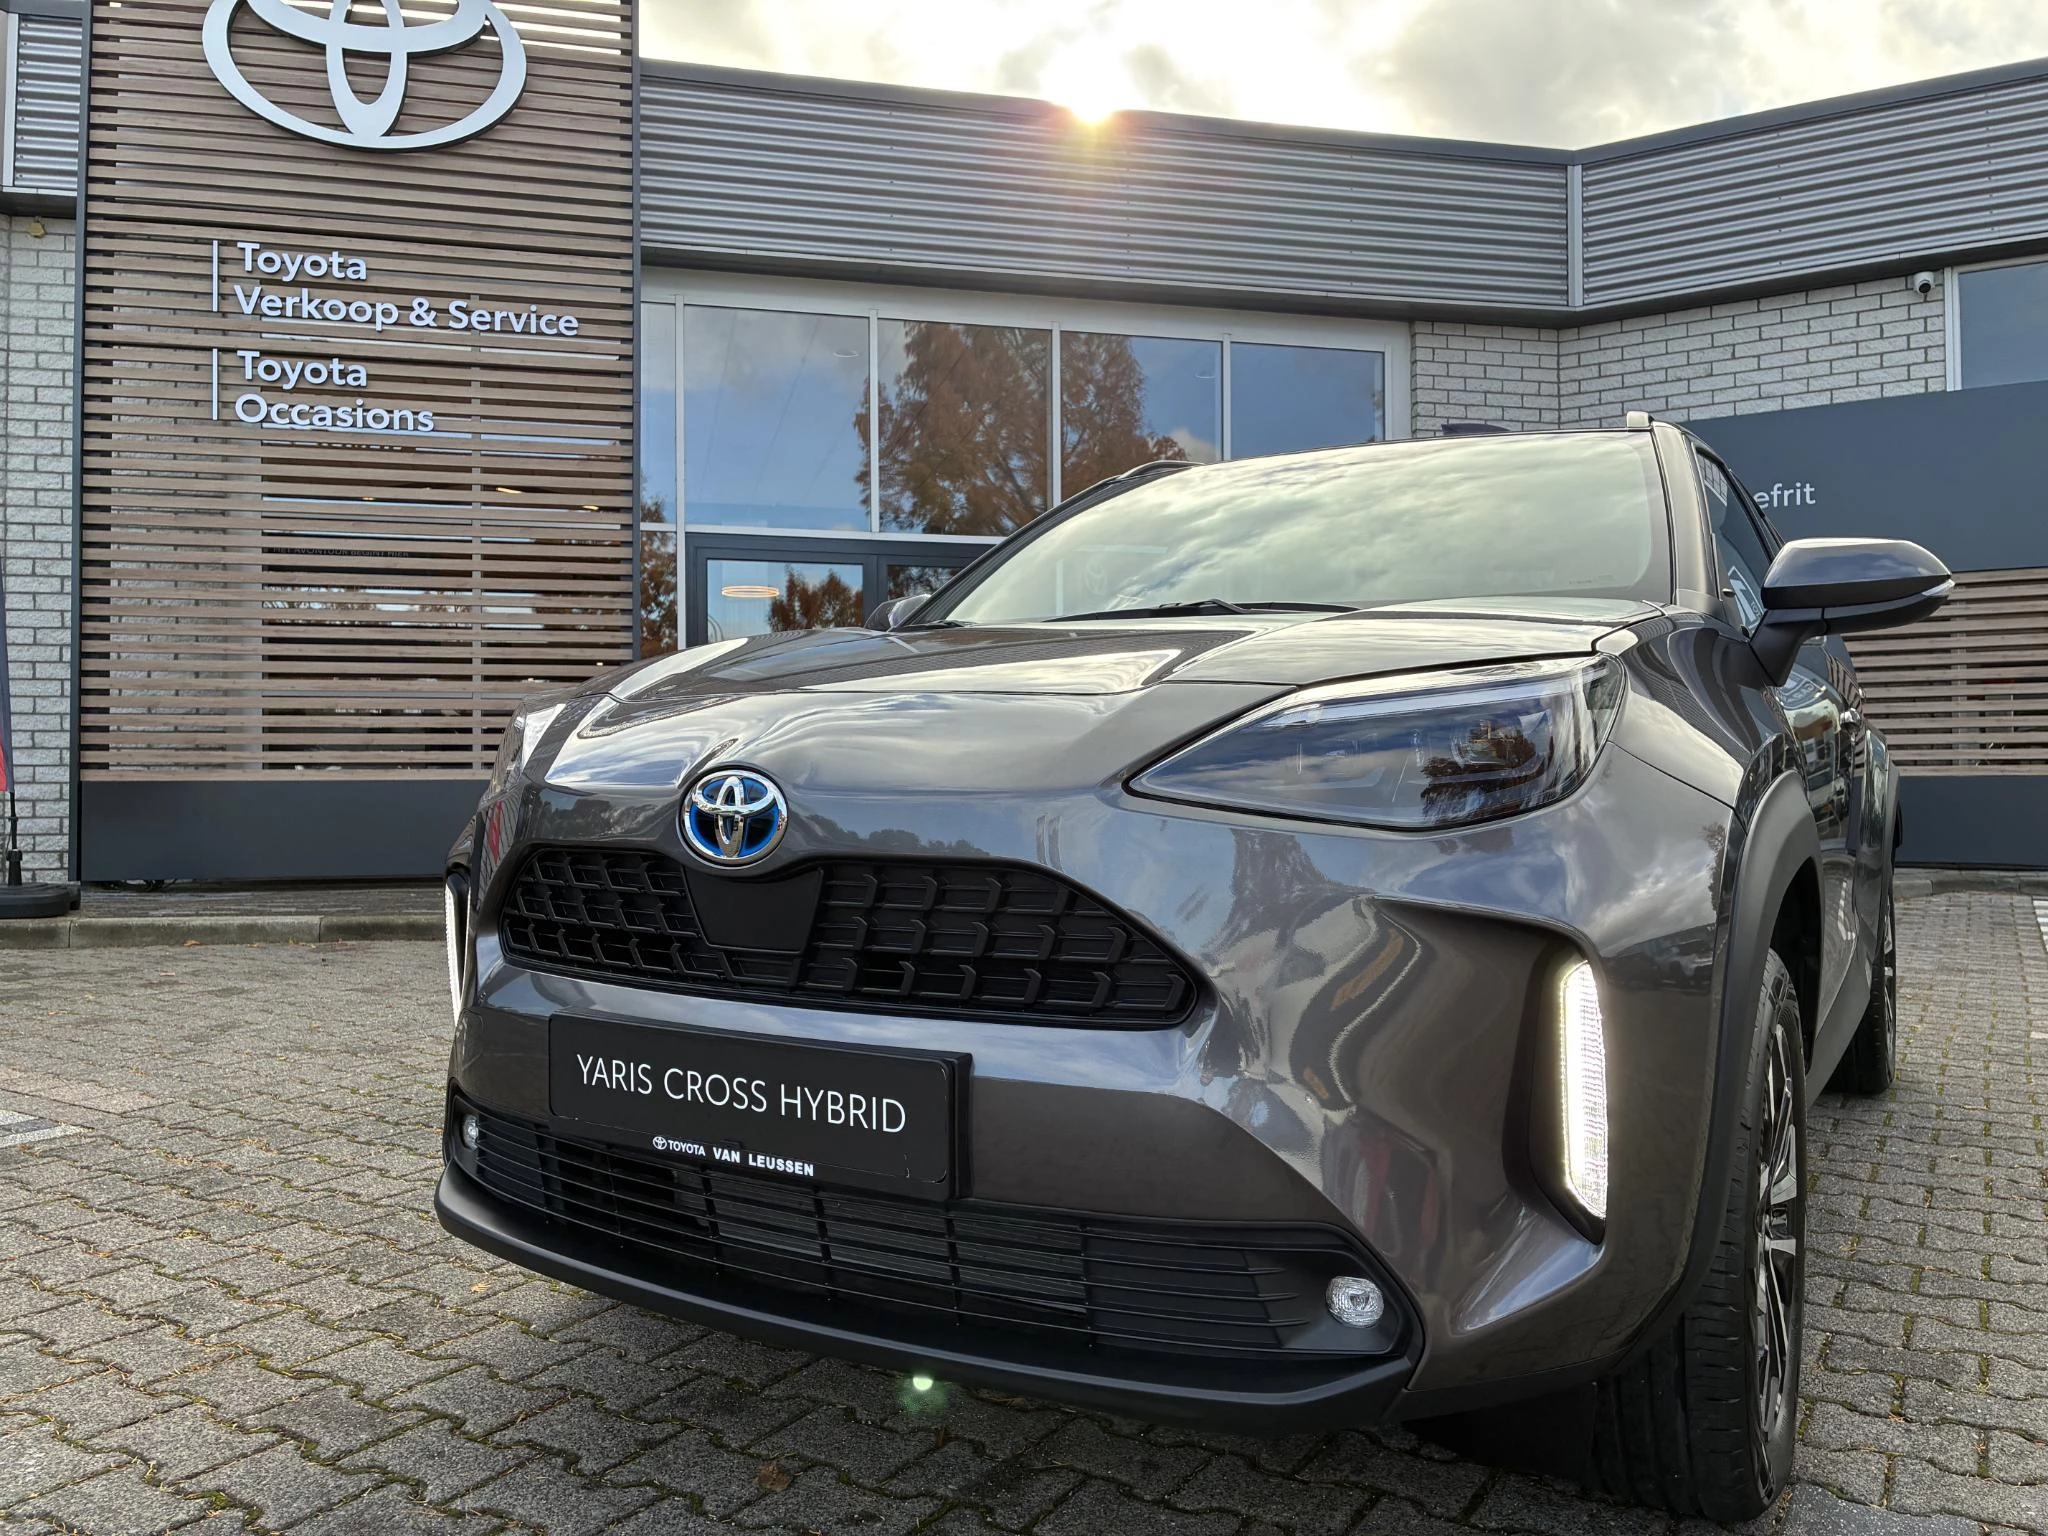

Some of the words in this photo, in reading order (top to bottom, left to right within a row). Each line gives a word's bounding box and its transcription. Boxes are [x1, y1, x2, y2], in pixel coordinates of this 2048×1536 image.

[236, 241, 367, 283] Toyota
[233, 284, 399, 332] Verkoop
[408, 297, 438, 328] &
[448, 300, 579, 337] Service
[236, 349, 368, 390] Toyota
[234, 393, 435, 433] Occasions
[1753, 481, 1817, 509] efrit
[576, 1053, 653, 1095] YARIS
[663, 1067, 768, 1113] CROSS
[780, 1083, 907, 1134] HYBRID
[667, 1139, 706, 1157] TOYOTA
[712, 1146, 741, 1164] VAN
[748, 1153, 815, 1177] LEUSSEN
